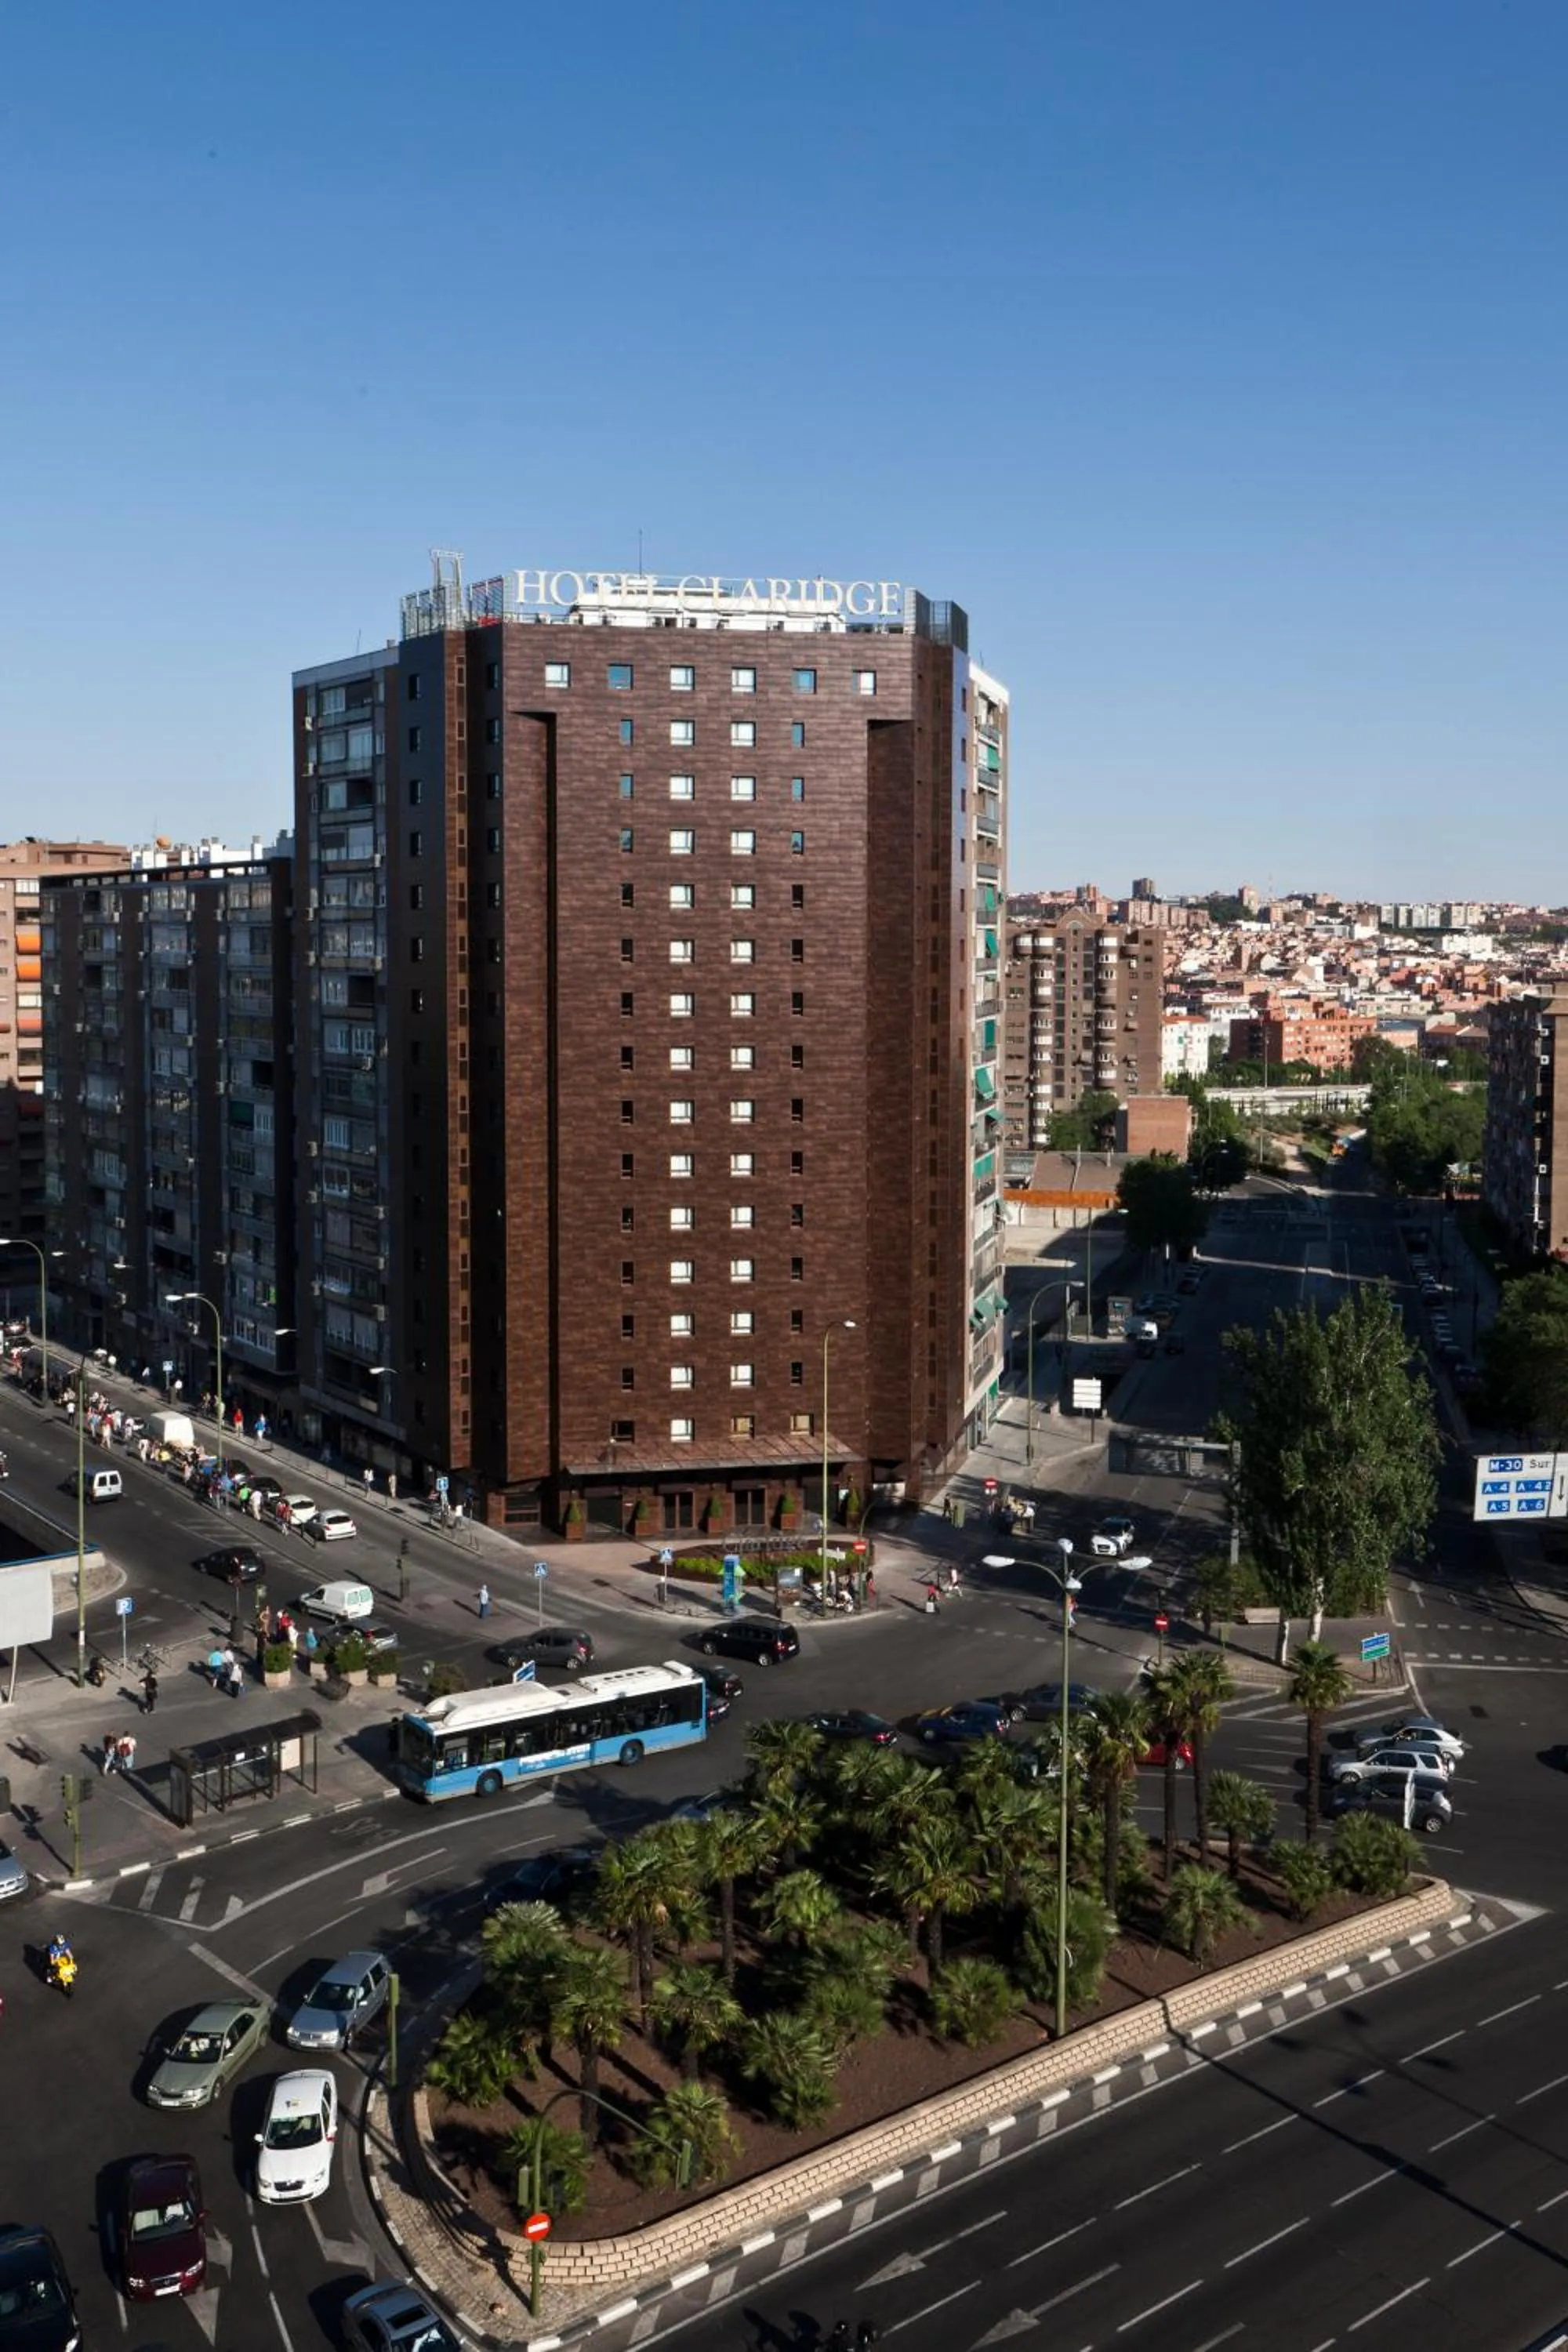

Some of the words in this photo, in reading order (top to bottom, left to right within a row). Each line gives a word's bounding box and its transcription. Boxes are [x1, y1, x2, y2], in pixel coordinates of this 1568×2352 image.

[514, 570, 674, 606] HOTEL
[677, 575, 901, 615] CLARIDGE
[1490, 1460, 1522, 1471] M-30
[1530, 1459, 1550, 1468] Sur
[1484, 1483, 1508, 1493] A-4
[1490, 1501, 1509, 1512] A-5
[1519, 1500, 1544, 1511] A-6
